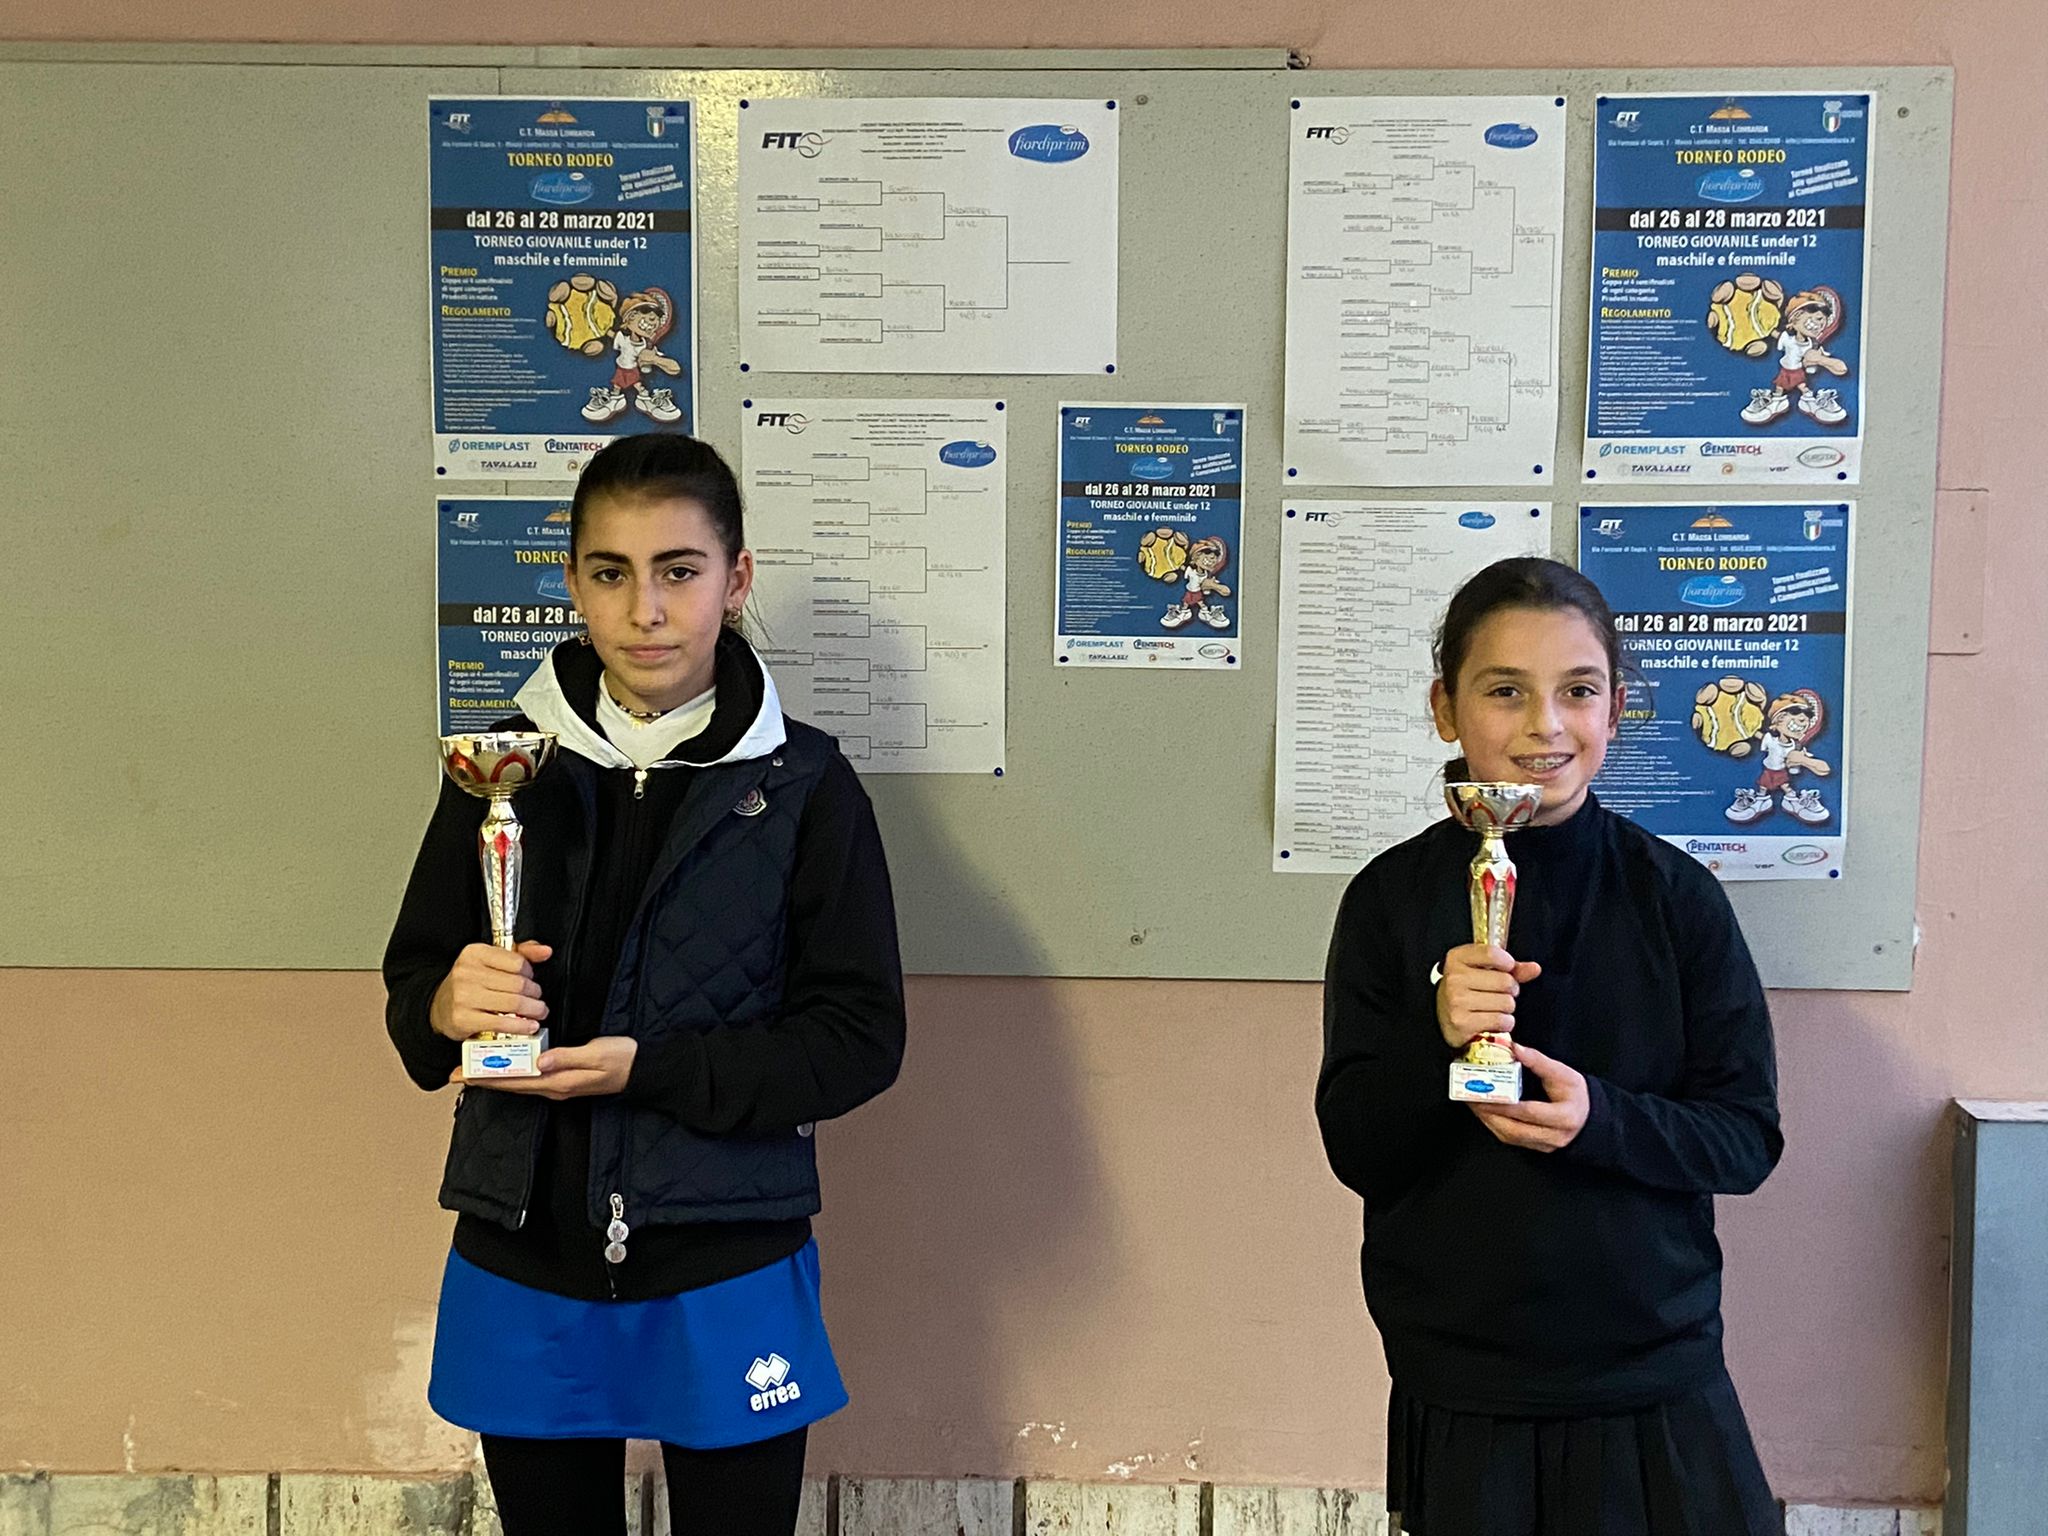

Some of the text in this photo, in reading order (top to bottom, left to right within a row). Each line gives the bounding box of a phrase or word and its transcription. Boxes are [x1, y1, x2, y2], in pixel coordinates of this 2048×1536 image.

[1616, 111, 1640, 122] FIT
[1306, 127, 1335, 139] FIT
[762, 132, 803, 149] FIT
[1012, 132, 1087, 158] fiordiprimi
[507, 152, 614, 167] TORNEO RODEO
[1675, 149, 1786, 165] TORNEO RODEO
[466, 211, 655, 230] dal 26 al 28 marzo 2021
[1629, 209, 1826, 229] dal 26 al 28 marzo 2021
[474, 235, 647, 249] TORNEO GIOVANILE under 12
[1637, 235, 1817, 249] TORNEO GIOVANILE under 12
[494, 252, 628, 268] maschile e femminile
[1656, 252, 1796, 267] maschile e femminile
[1602, 267, 1639, 278] PREMIO
[1601, 307, 1671, 318] REGOLAMENTO
[757, 413, 790, 426] FIT
[462, 440, 603, 451] OREMPLAST PENTATECH
[1115, 444, 1189, 454] TORNEO RODEO
[1613, 445, 1762, 455] OREMPLAST PENTATECH
[1085, 483, 1216, 498] dal 26 al 28 marzo 2021
[1090, 500, 1211, 510] TORNEO GIOVANILE under 12
[457, 512, 479, 523] FIT
[1103, 512, 1142, 521] maschile
[1151, 512, 1197, 522] femminile
[1305, 512, 1328, 522] FIT
[1600, 519, 1623, 530] FIT
[514, 550, 568, 564] TORNEO
[1659, 557, 1767, 571] TORNEO RODEO
[473, 607, 497, 623] dal
[501, 607, 521, 623] 26
[526, 607, 540, 623] al
[544, 607, 564, 624] 28
[1614, 614, 1808, 632] dal 26 al 28 marzo 2021
[480, 631, 528, 642] TORNEO
[1622, 639, 1799, 651] TORNEO GIOVANILE under 12
[501, 647, 548, 660] maschil
[448, 660, 485, 670] PREMIO
[1641, 655, 1779, 669] maschile e femminile
[449, 697, 518, 709] REGOLAMENTO
[1691, 842, 1747, 853] PENTATECH
[750, 1381, 801, 1412] errea
